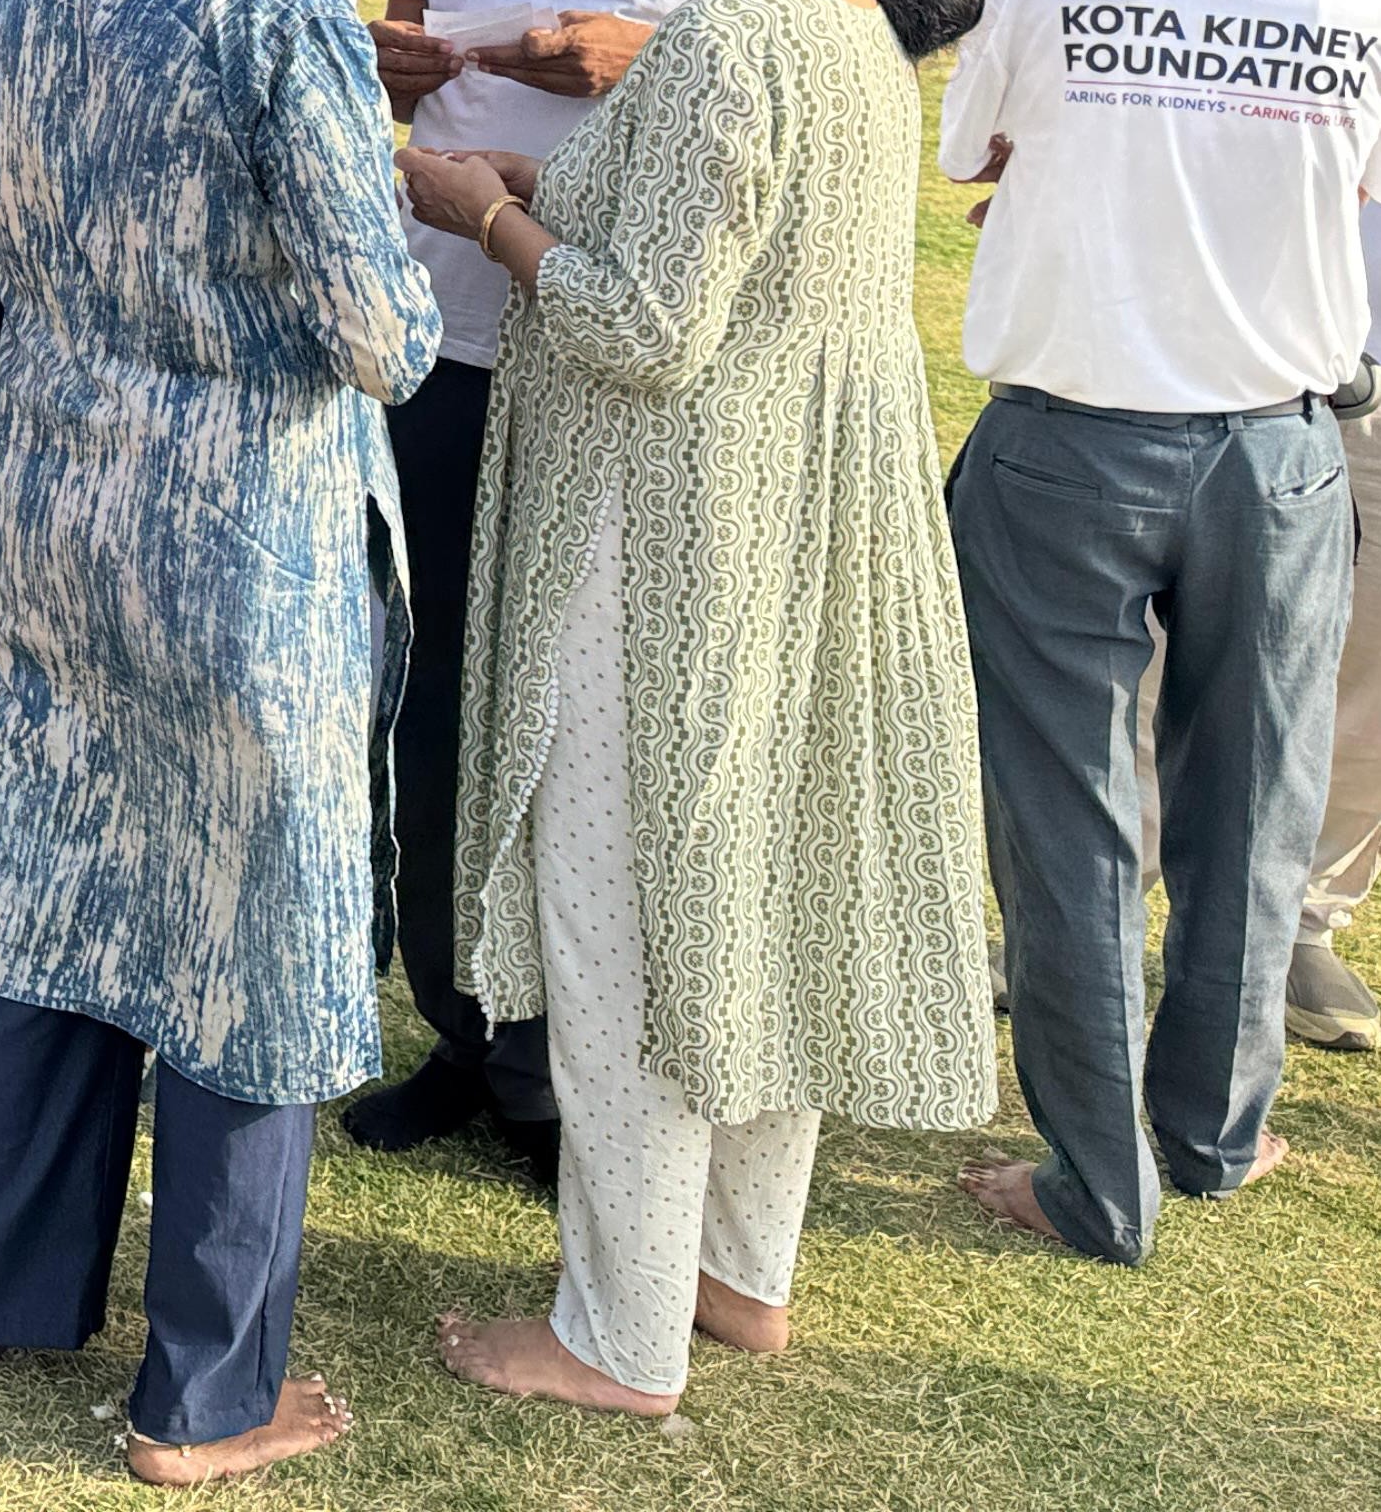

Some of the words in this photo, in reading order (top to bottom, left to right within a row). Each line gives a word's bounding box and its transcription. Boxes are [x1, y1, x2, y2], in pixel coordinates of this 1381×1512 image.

[1061, 5, 1186, 40] KOTA
[1203, 15, 1378, 62] KIDNEY
[1064, 43, 1367, 99] FOUNDATION
[1122, 92, 1152, 106] FOR
[1158, 96, 1226, 113] KIDNEYS
[1240, 104, 1300, 123] CARING
[1304, 111, 1330, 126] FOR
